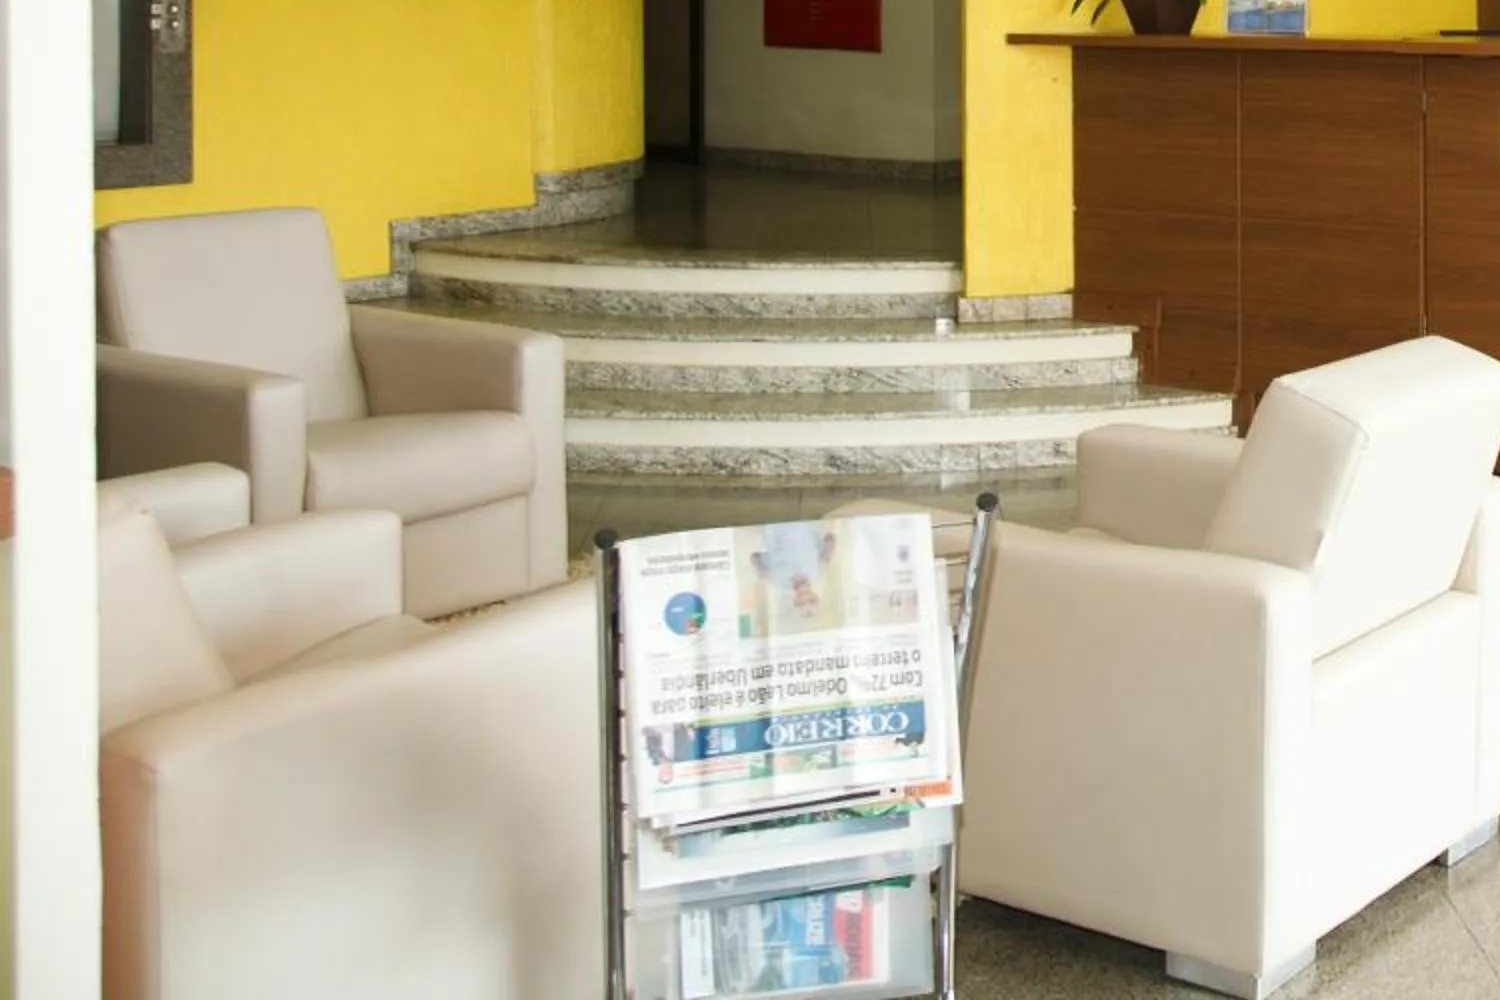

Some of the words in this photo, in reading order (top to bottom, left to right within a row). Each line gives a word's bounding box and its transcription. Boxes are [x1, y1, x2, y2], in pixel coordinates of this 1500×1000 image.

[750, 664, 774, 681] em
[776, 655, 851, 680] mandato
[889, 670, 923, 691] Com
[764, 710, 910, 747] CORREIO
